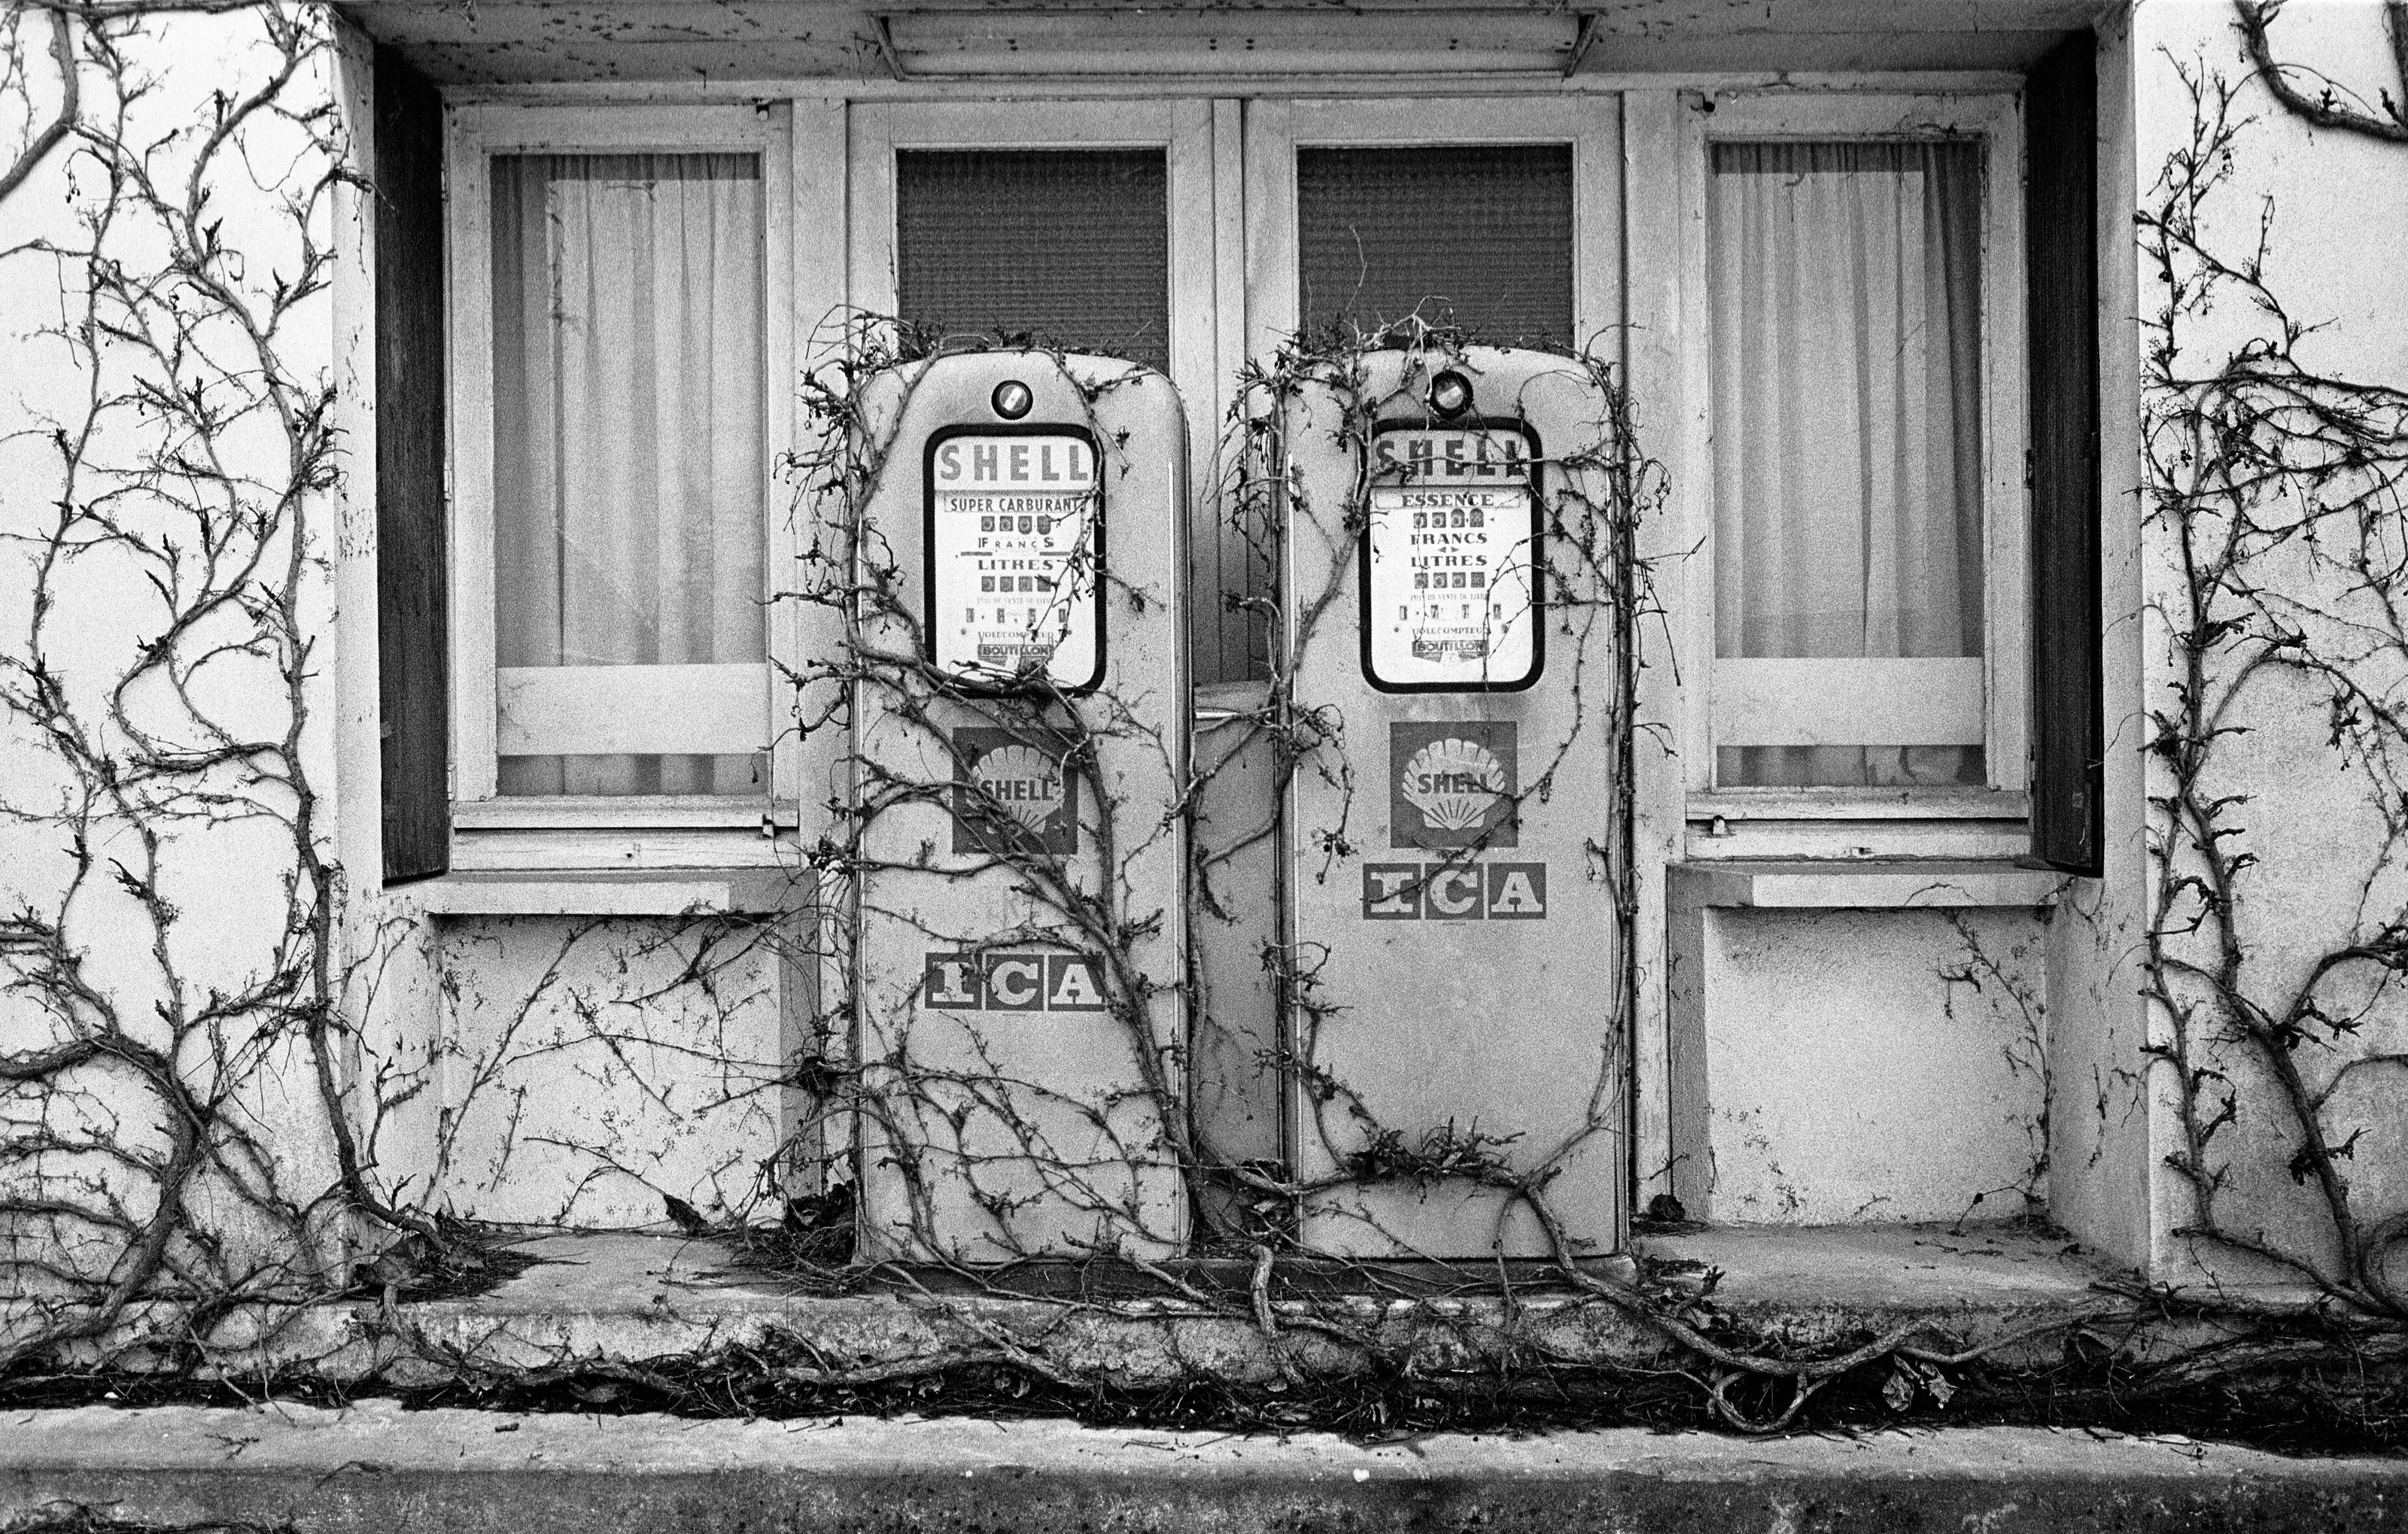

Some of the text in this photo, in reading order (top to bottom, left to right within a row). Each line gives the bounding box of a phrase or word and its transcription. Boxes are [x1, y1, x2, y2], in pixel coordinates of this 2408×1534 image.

[941, 445, 1089, 481] SHELL
[1376, 439, 1526, 476] SHELL
[950, 498, 1078, 512] SUPER CARBURANT
[1401, 494, 1494, 507] ESSENCE
[978, 537, 1054, 548] FRANCS
[1411, 533, 1488, 545] FRANCS
[977, 559, 1054, 570] LITRES
[1411, 555, 1488, 567] LITRES
[980, 779, 1054, 801] SHELL
[1418, 773, 1488, 794] SHELL
[1370, 870, 1543, 915] ICA
[932, 960, 1102, 1006] ICA
